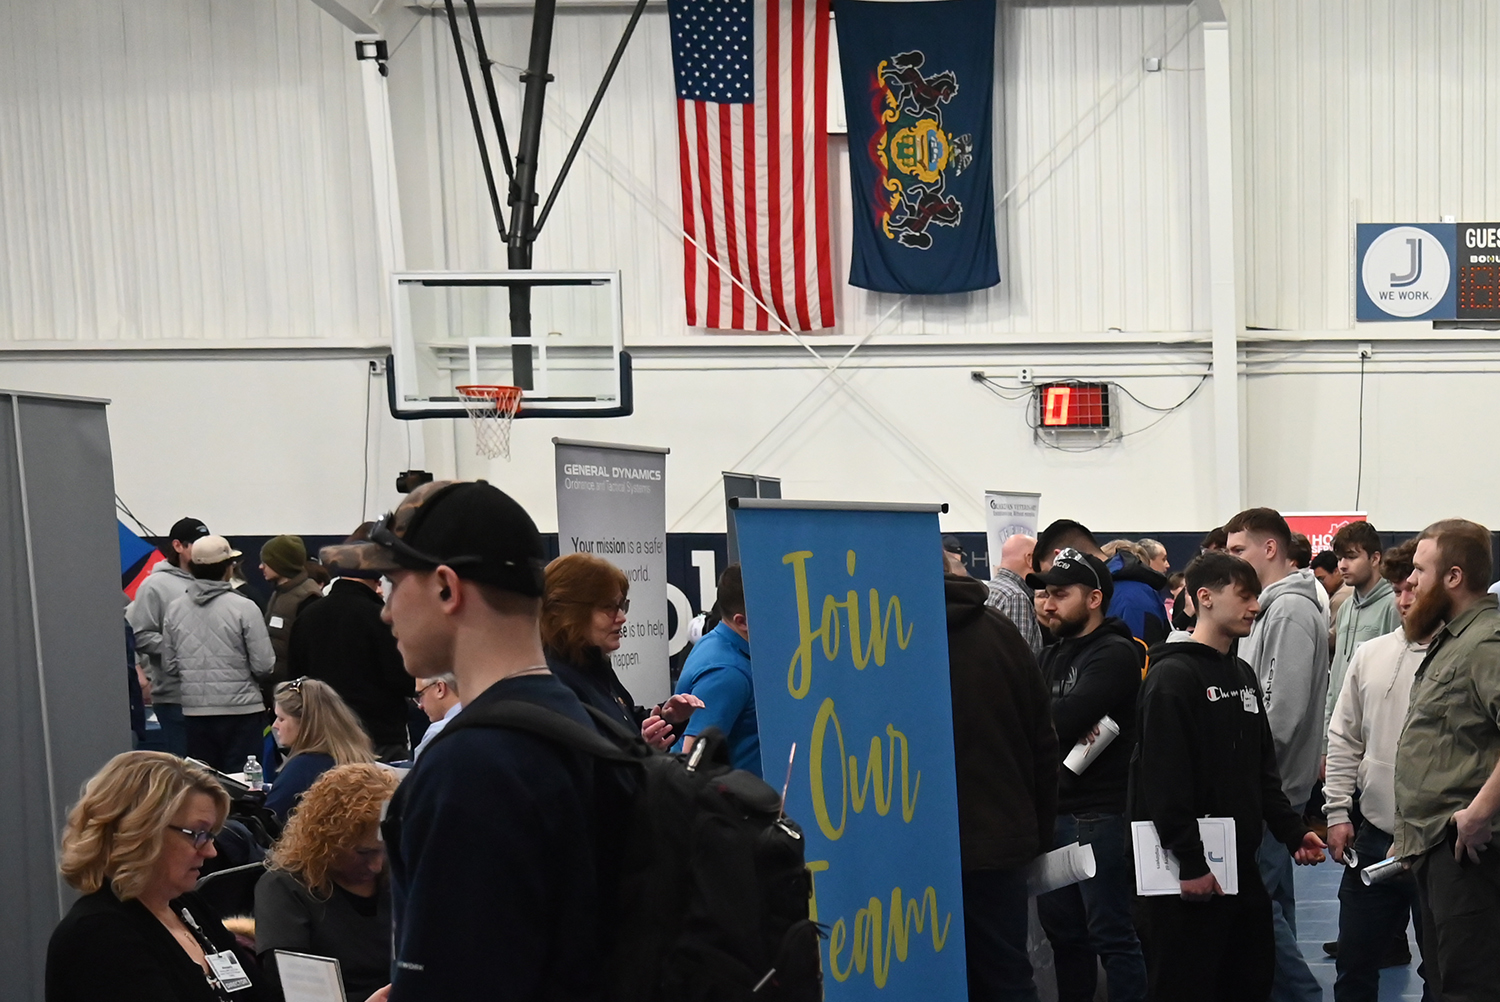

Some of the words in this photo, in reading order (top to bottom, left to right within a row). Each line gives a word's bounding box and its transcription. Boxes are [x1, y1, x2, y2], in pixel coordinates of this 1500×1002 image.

[1379, 291, 1394, 301] WE
[1397, 291, 1433, 301] WORK.
[564, 463, 609, 477] GENERAL
[612, 466, 661, 480] DYNAMICS
[564, 477, 595, 491] Ordnance
[571, 537, 594, 554] Your
[596, 537, 626, 554] mission
[627, 537, 635, 554] is
[636, 540, 642, 554] a
[628, 621, 636, 638] is
[636, 622, 645, 637] to
[647, 619, 665, 639] help
[782, 549, 914, 700] Join
[809, 697, 921, 841] Our
[805, 860, 951, 995] Team
